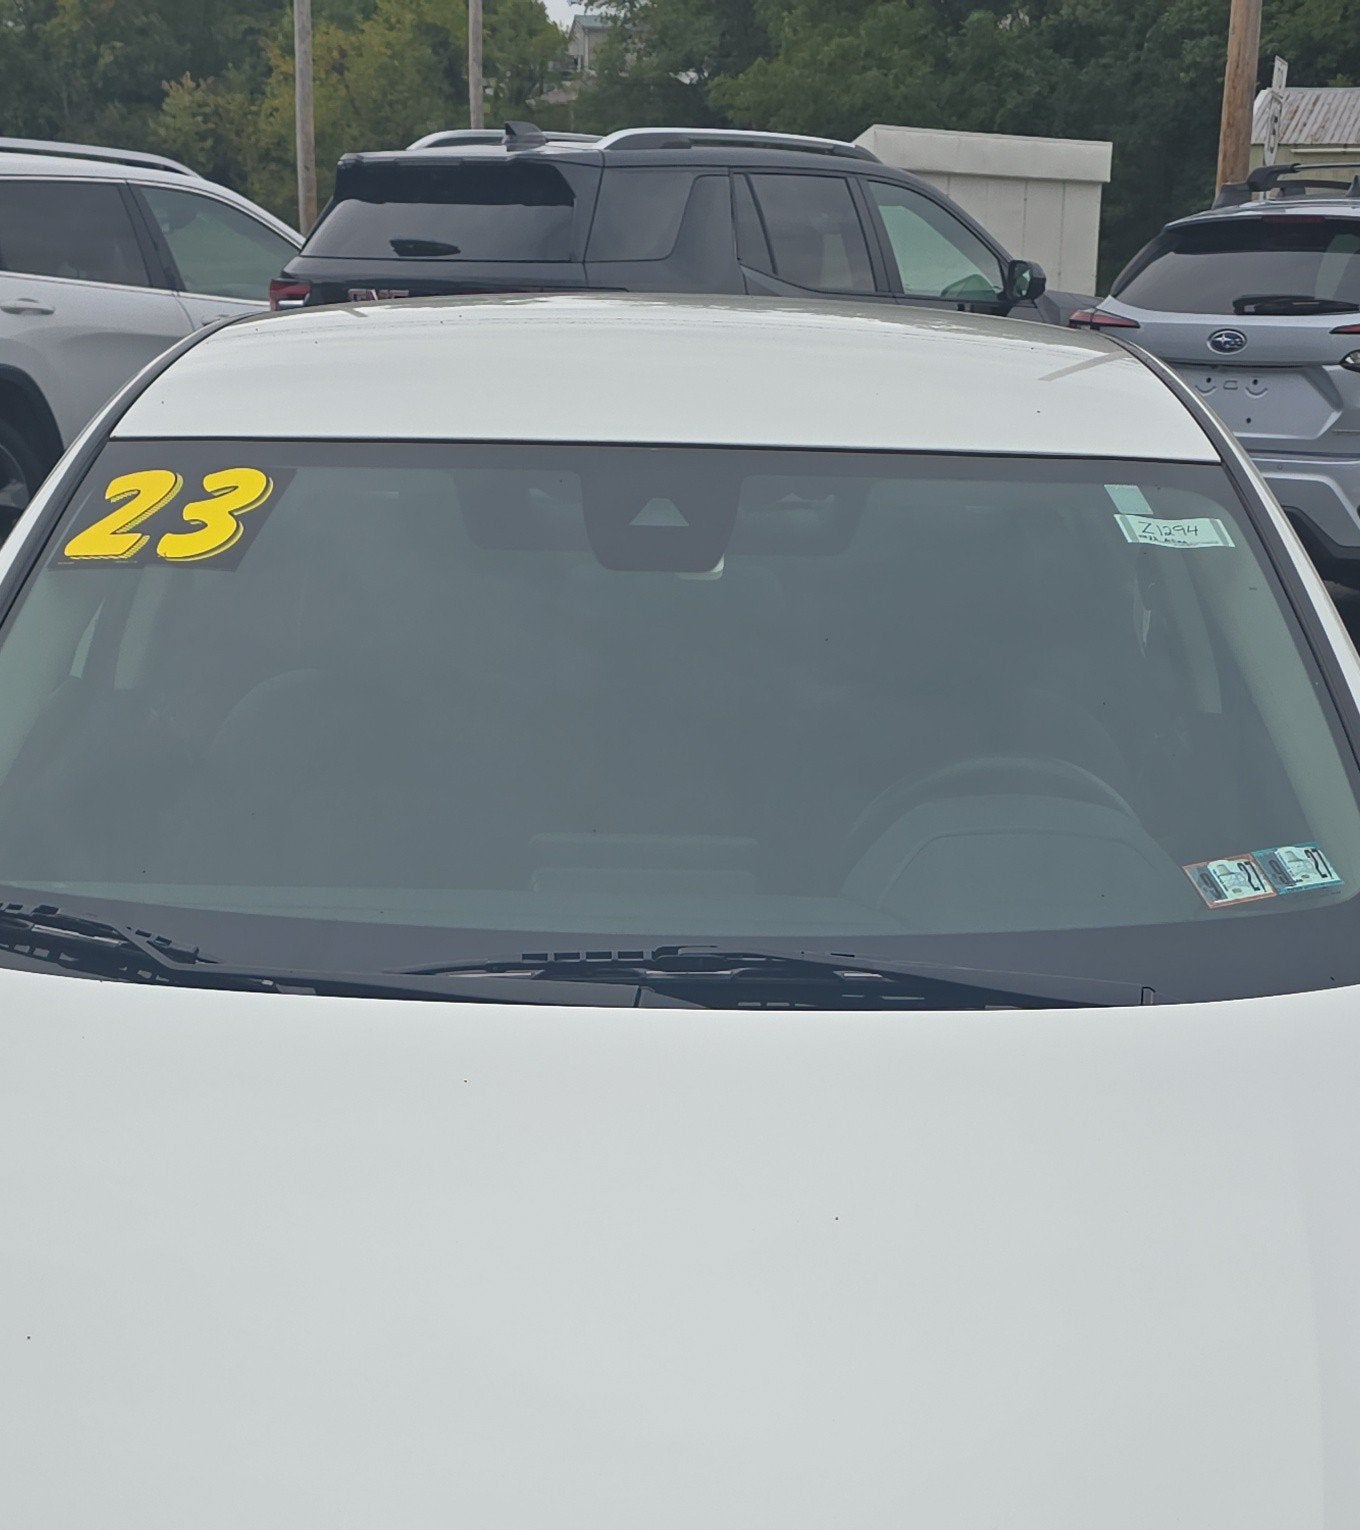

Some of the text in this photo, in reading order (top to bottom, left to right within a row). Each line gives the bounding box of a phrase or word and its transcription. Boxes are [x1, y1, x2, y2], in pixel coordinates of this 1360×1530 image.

[64, 467, 274, 562] 23
[1138, 521, 1198, 537] Z1294
[1237, 861, 1267, 893] 27
[1305, 848, 1334, 880] 27
